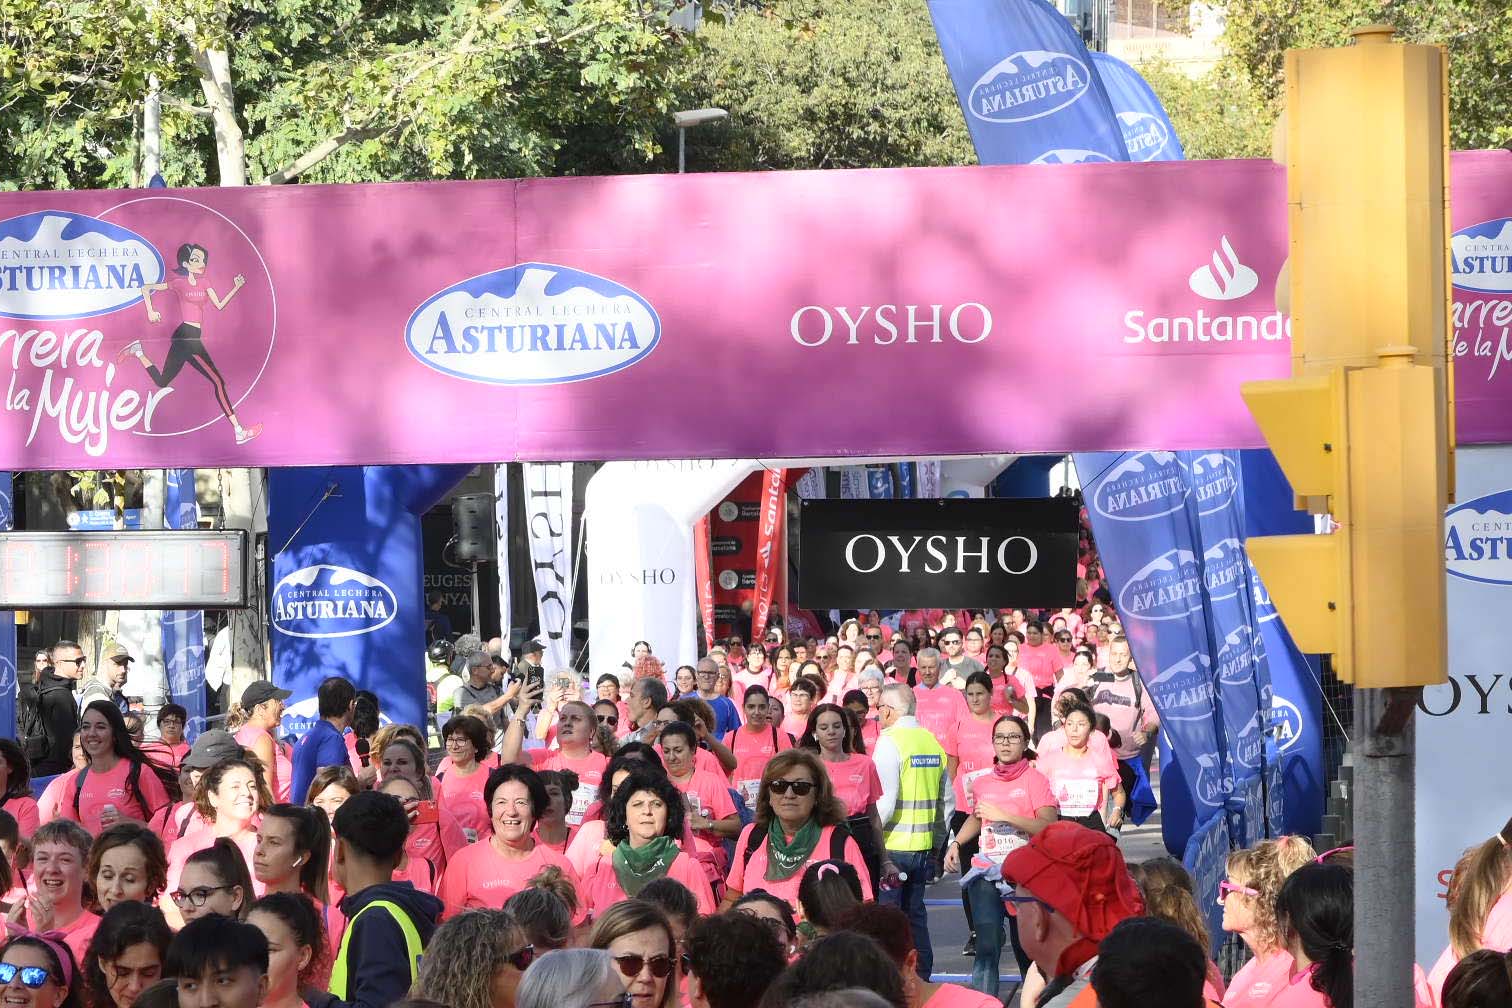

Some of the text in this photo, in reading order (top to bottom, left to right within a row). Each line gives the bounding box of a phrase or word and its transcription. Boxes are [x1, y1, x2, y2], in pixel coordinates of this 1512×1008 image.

[67, 247, 140, 259] LECHERA
[464, 305, 543, 319] CENTRAL
[790, 303, 993, 347] OYSHO
[1123, 309, 1292, 344] Santand
[425, 311, 641, 355] ASTURIANA
[5, 371, 31, 411] la
[25, 362, 175, 457] Mujer
[845, 534, 1040, 575] OYSHO
[275, 594, 389, 621] ASTURIANA
[287, 589, 383, 598] CENTRAL LECHERA
